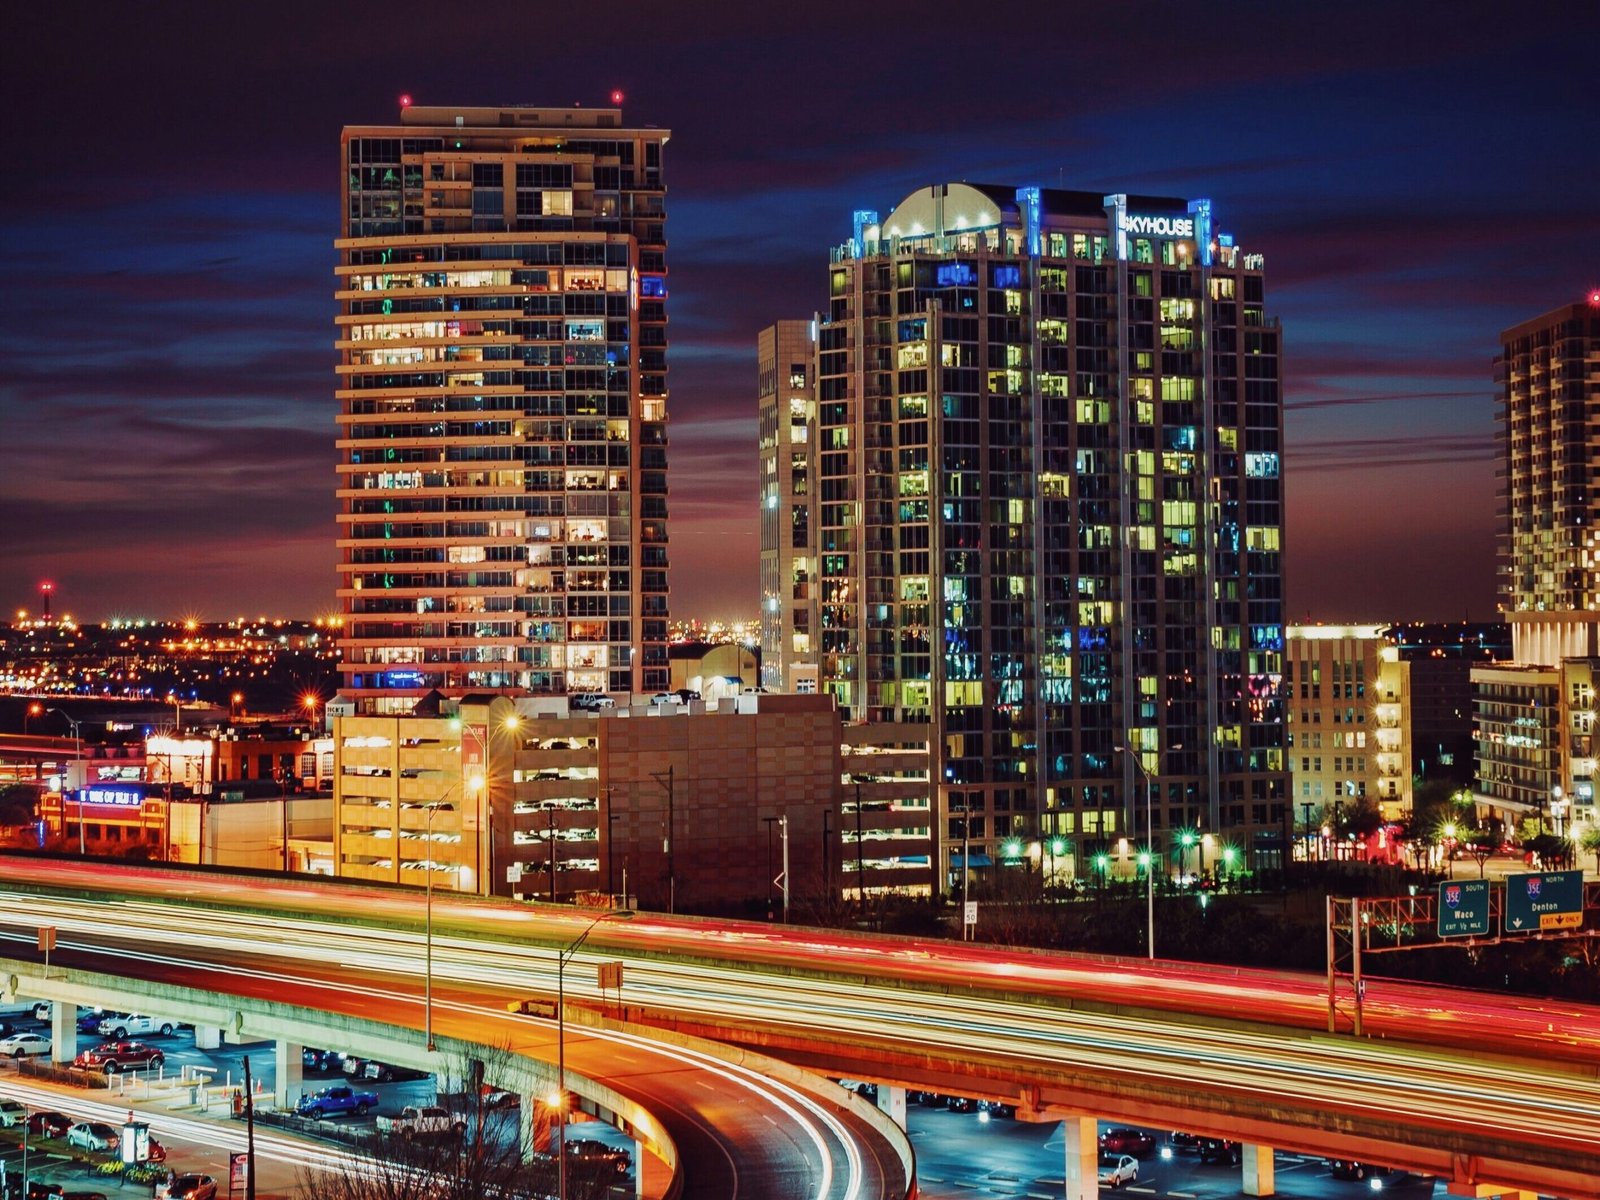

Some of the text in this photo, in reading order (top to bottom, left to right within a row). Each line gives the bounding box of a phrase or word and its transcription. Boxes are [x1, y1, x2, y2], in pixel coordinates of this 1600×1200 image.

[1527, 883, 1541, 894] 35E
[1446, 891, 1460, 903] 35E
[1531, 902, 1558, 912] Denton
[1454, 910, 1474, 919] Waco
